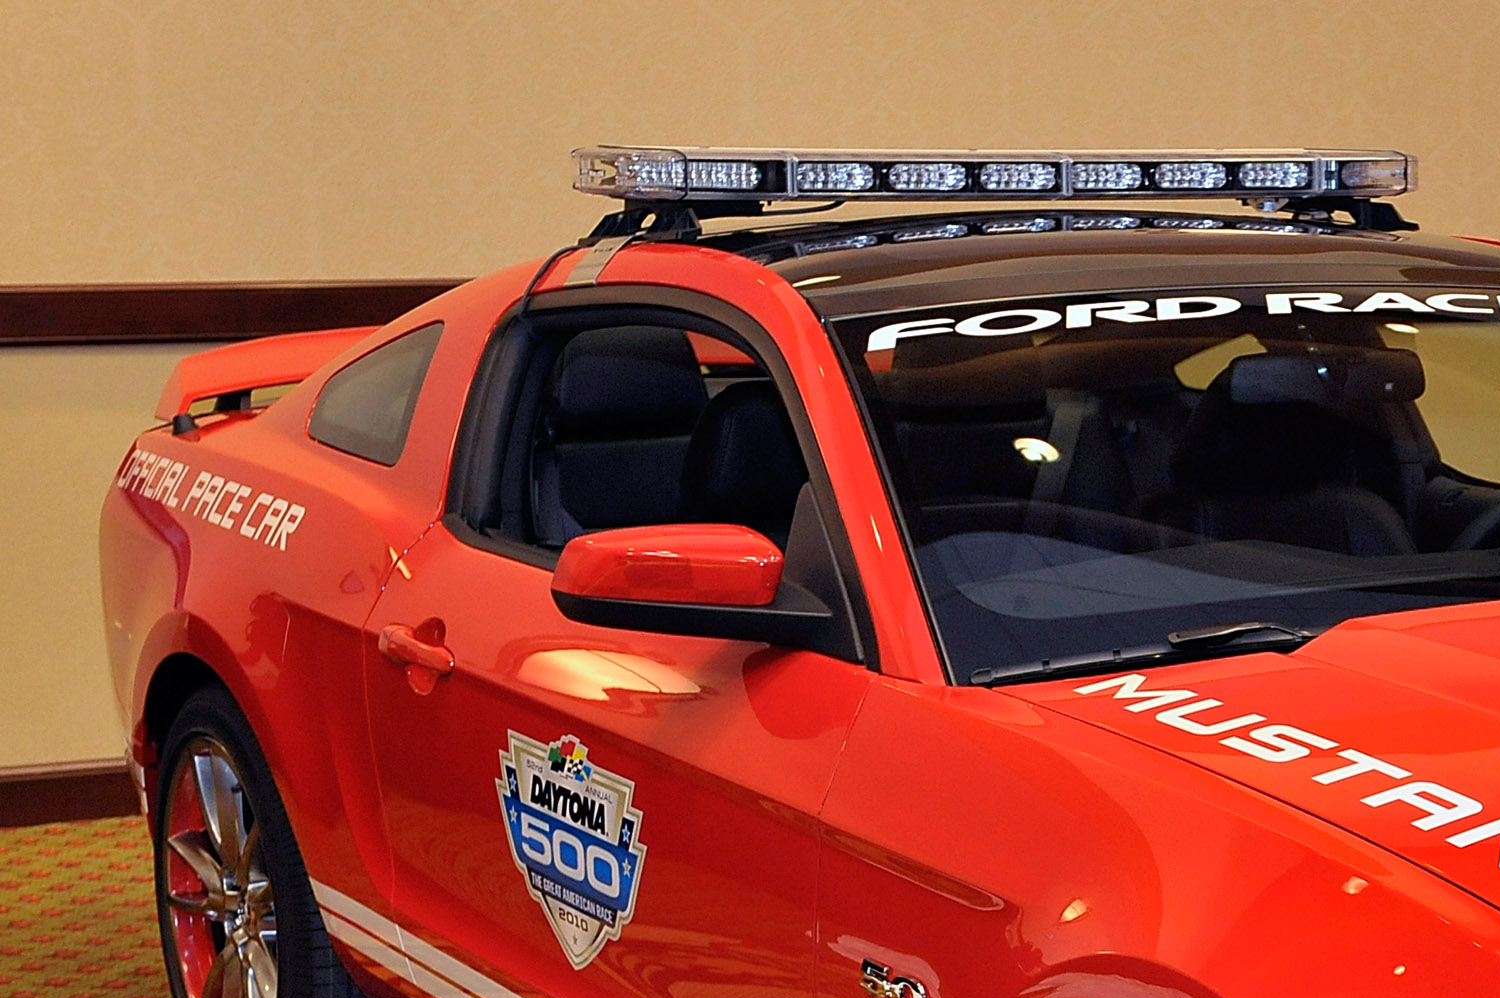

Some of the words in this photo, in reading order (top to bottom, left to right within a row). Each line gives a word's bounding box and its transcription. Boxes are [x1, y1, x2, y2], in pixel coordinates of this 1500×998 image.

[867, 295, 1242, 352] FORD
[117, 449, 189, 509] OFFICIAL
[181, 471, 252, 530] PACE
[240, 493, 306, 551] CAR
[520, 811, 620, 898] 500
[531, 872, 543, 889] THE
[543, 877, 562, 898] GREAT
[562, 888, 596, 917] AMERICAN
[595, 904, 614, 925] RACE
[558, 907, 589, 933] 2010
